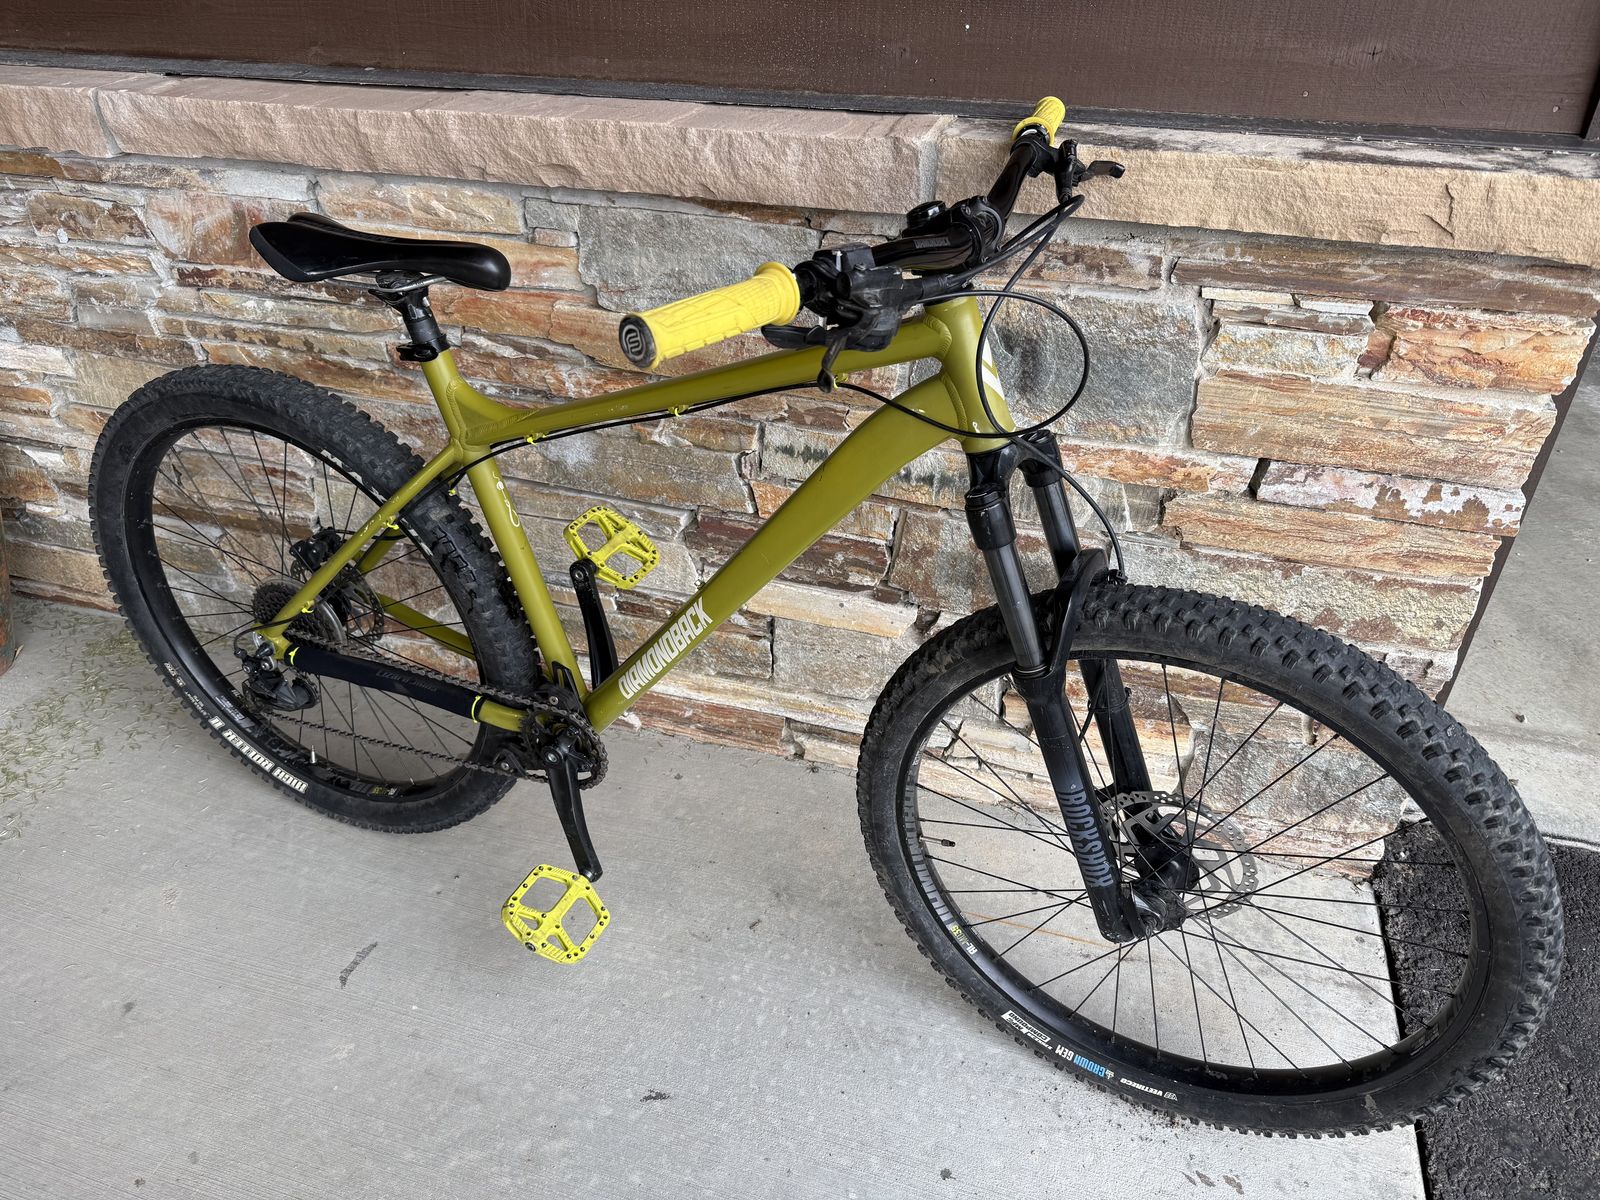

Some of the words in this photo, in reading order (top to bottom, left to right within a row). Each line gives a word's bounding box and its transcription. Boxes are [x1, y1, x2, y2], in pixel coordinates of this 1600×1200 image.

[618, 596, 713, 700] DIAMONDBACK
[208, 716, 225, 730] II
[222, 729, 275, 772] ROLLER
[273, 766, 308, 794] HIGH
[1057, 790, 1113, 887] ROCKSHOX
[1009, 1012, 1048, 1041] COMPOUND
[1055, 1044, 1074, 1061] GEM
[1073, 1055, 1106, 1077] CROWN
[1120, 1077, 1163, 1096] VEETIRECO
